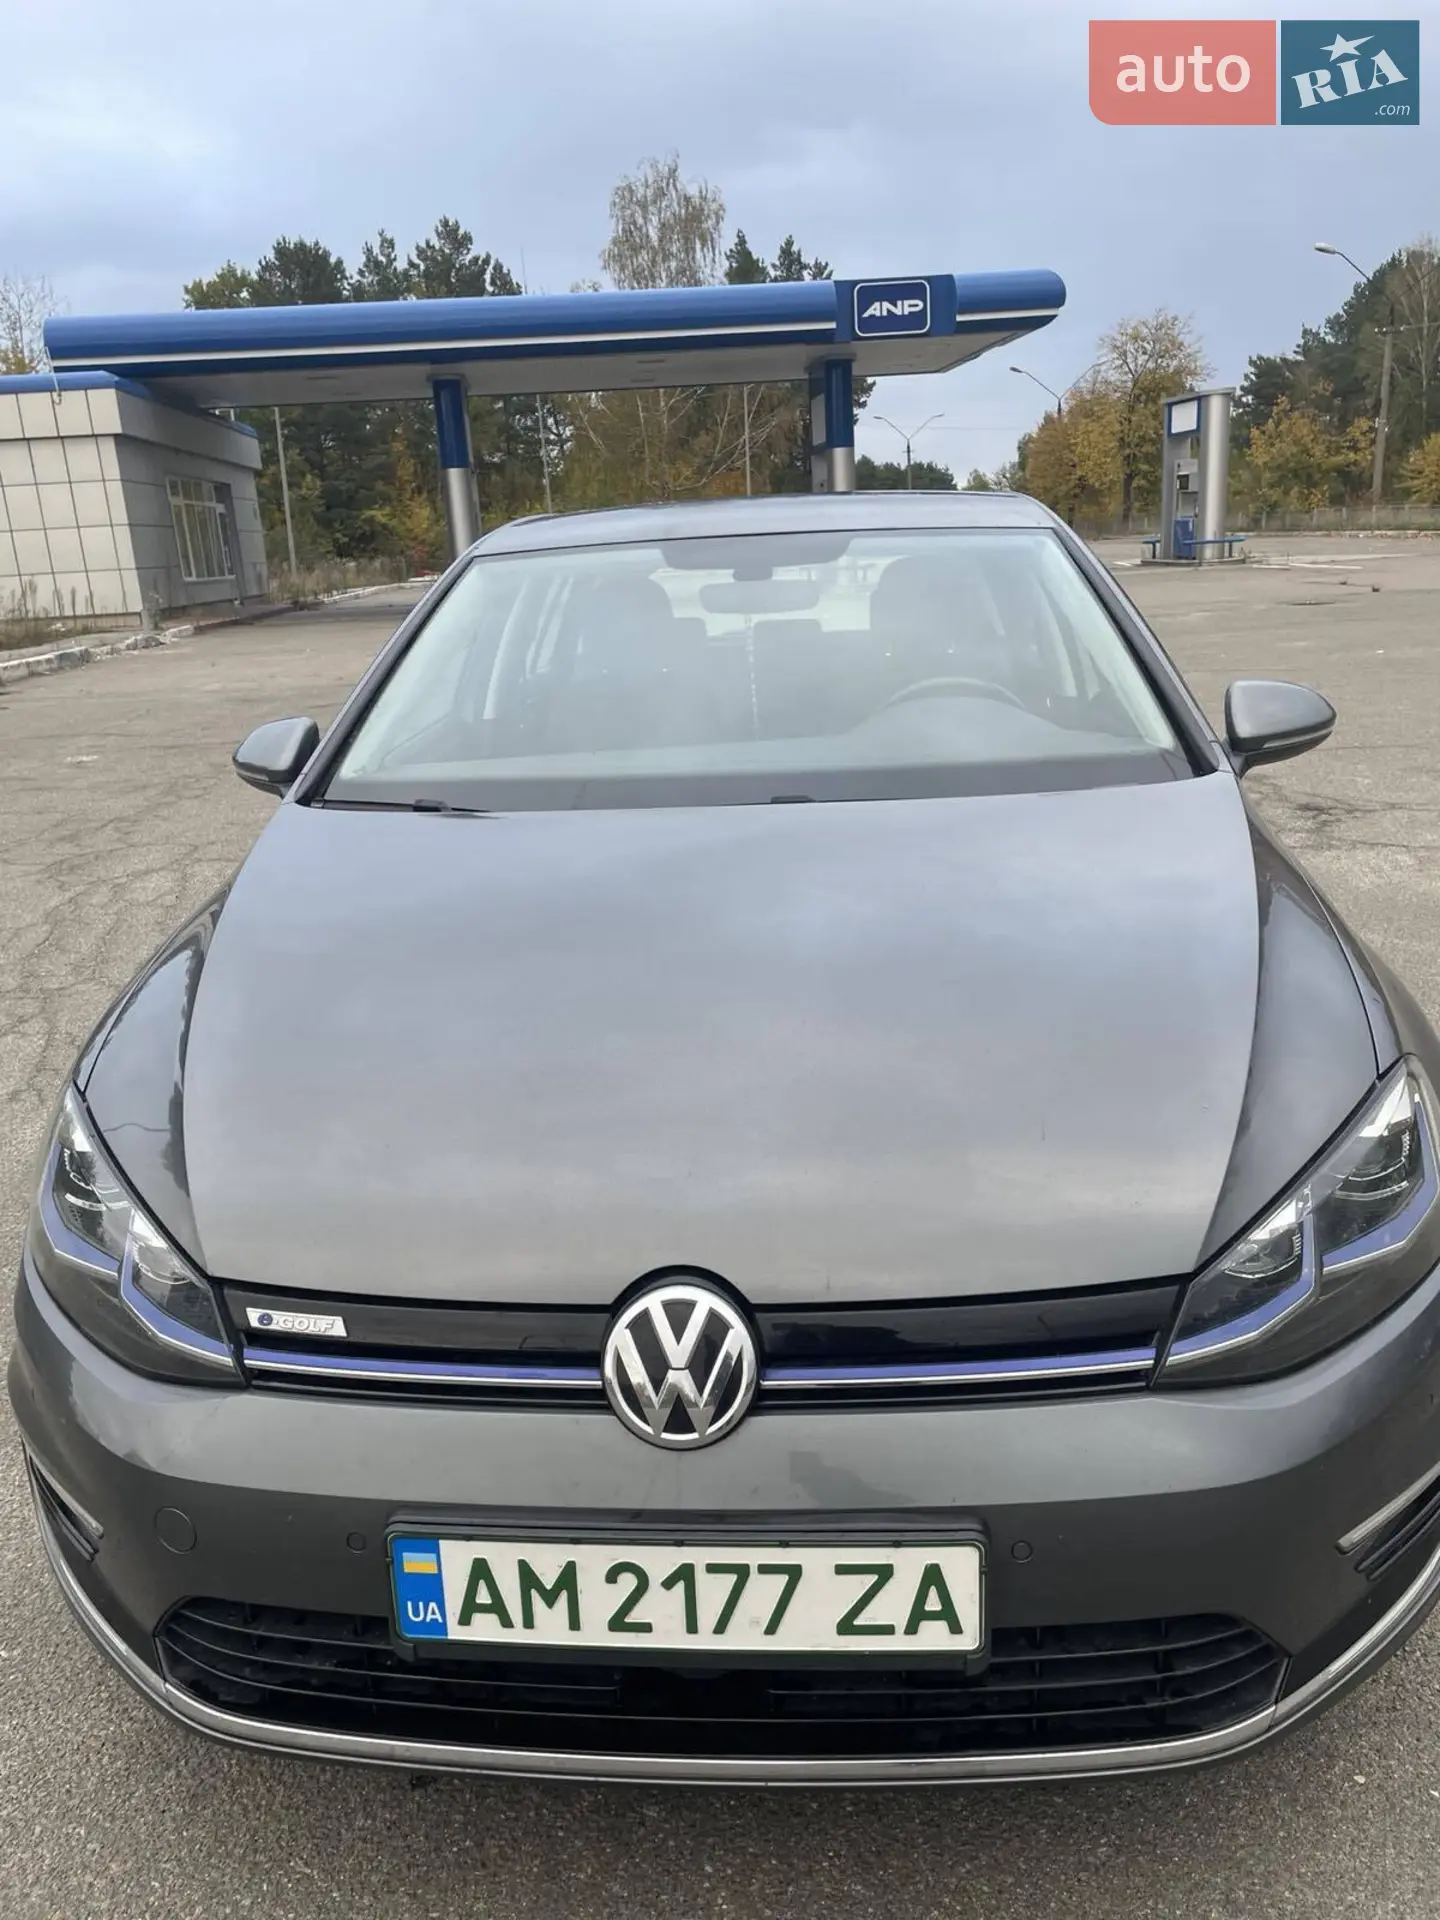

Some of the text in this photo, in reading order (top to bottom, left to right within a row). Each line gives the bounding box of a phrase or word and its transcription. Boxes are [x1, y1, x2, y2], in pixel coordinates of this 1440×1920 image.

[861, 299, 924, 318] ANP
[456, 1556, 965, 1636] AM 2177 ZA
[406, 1600, 444, 1624] UA
